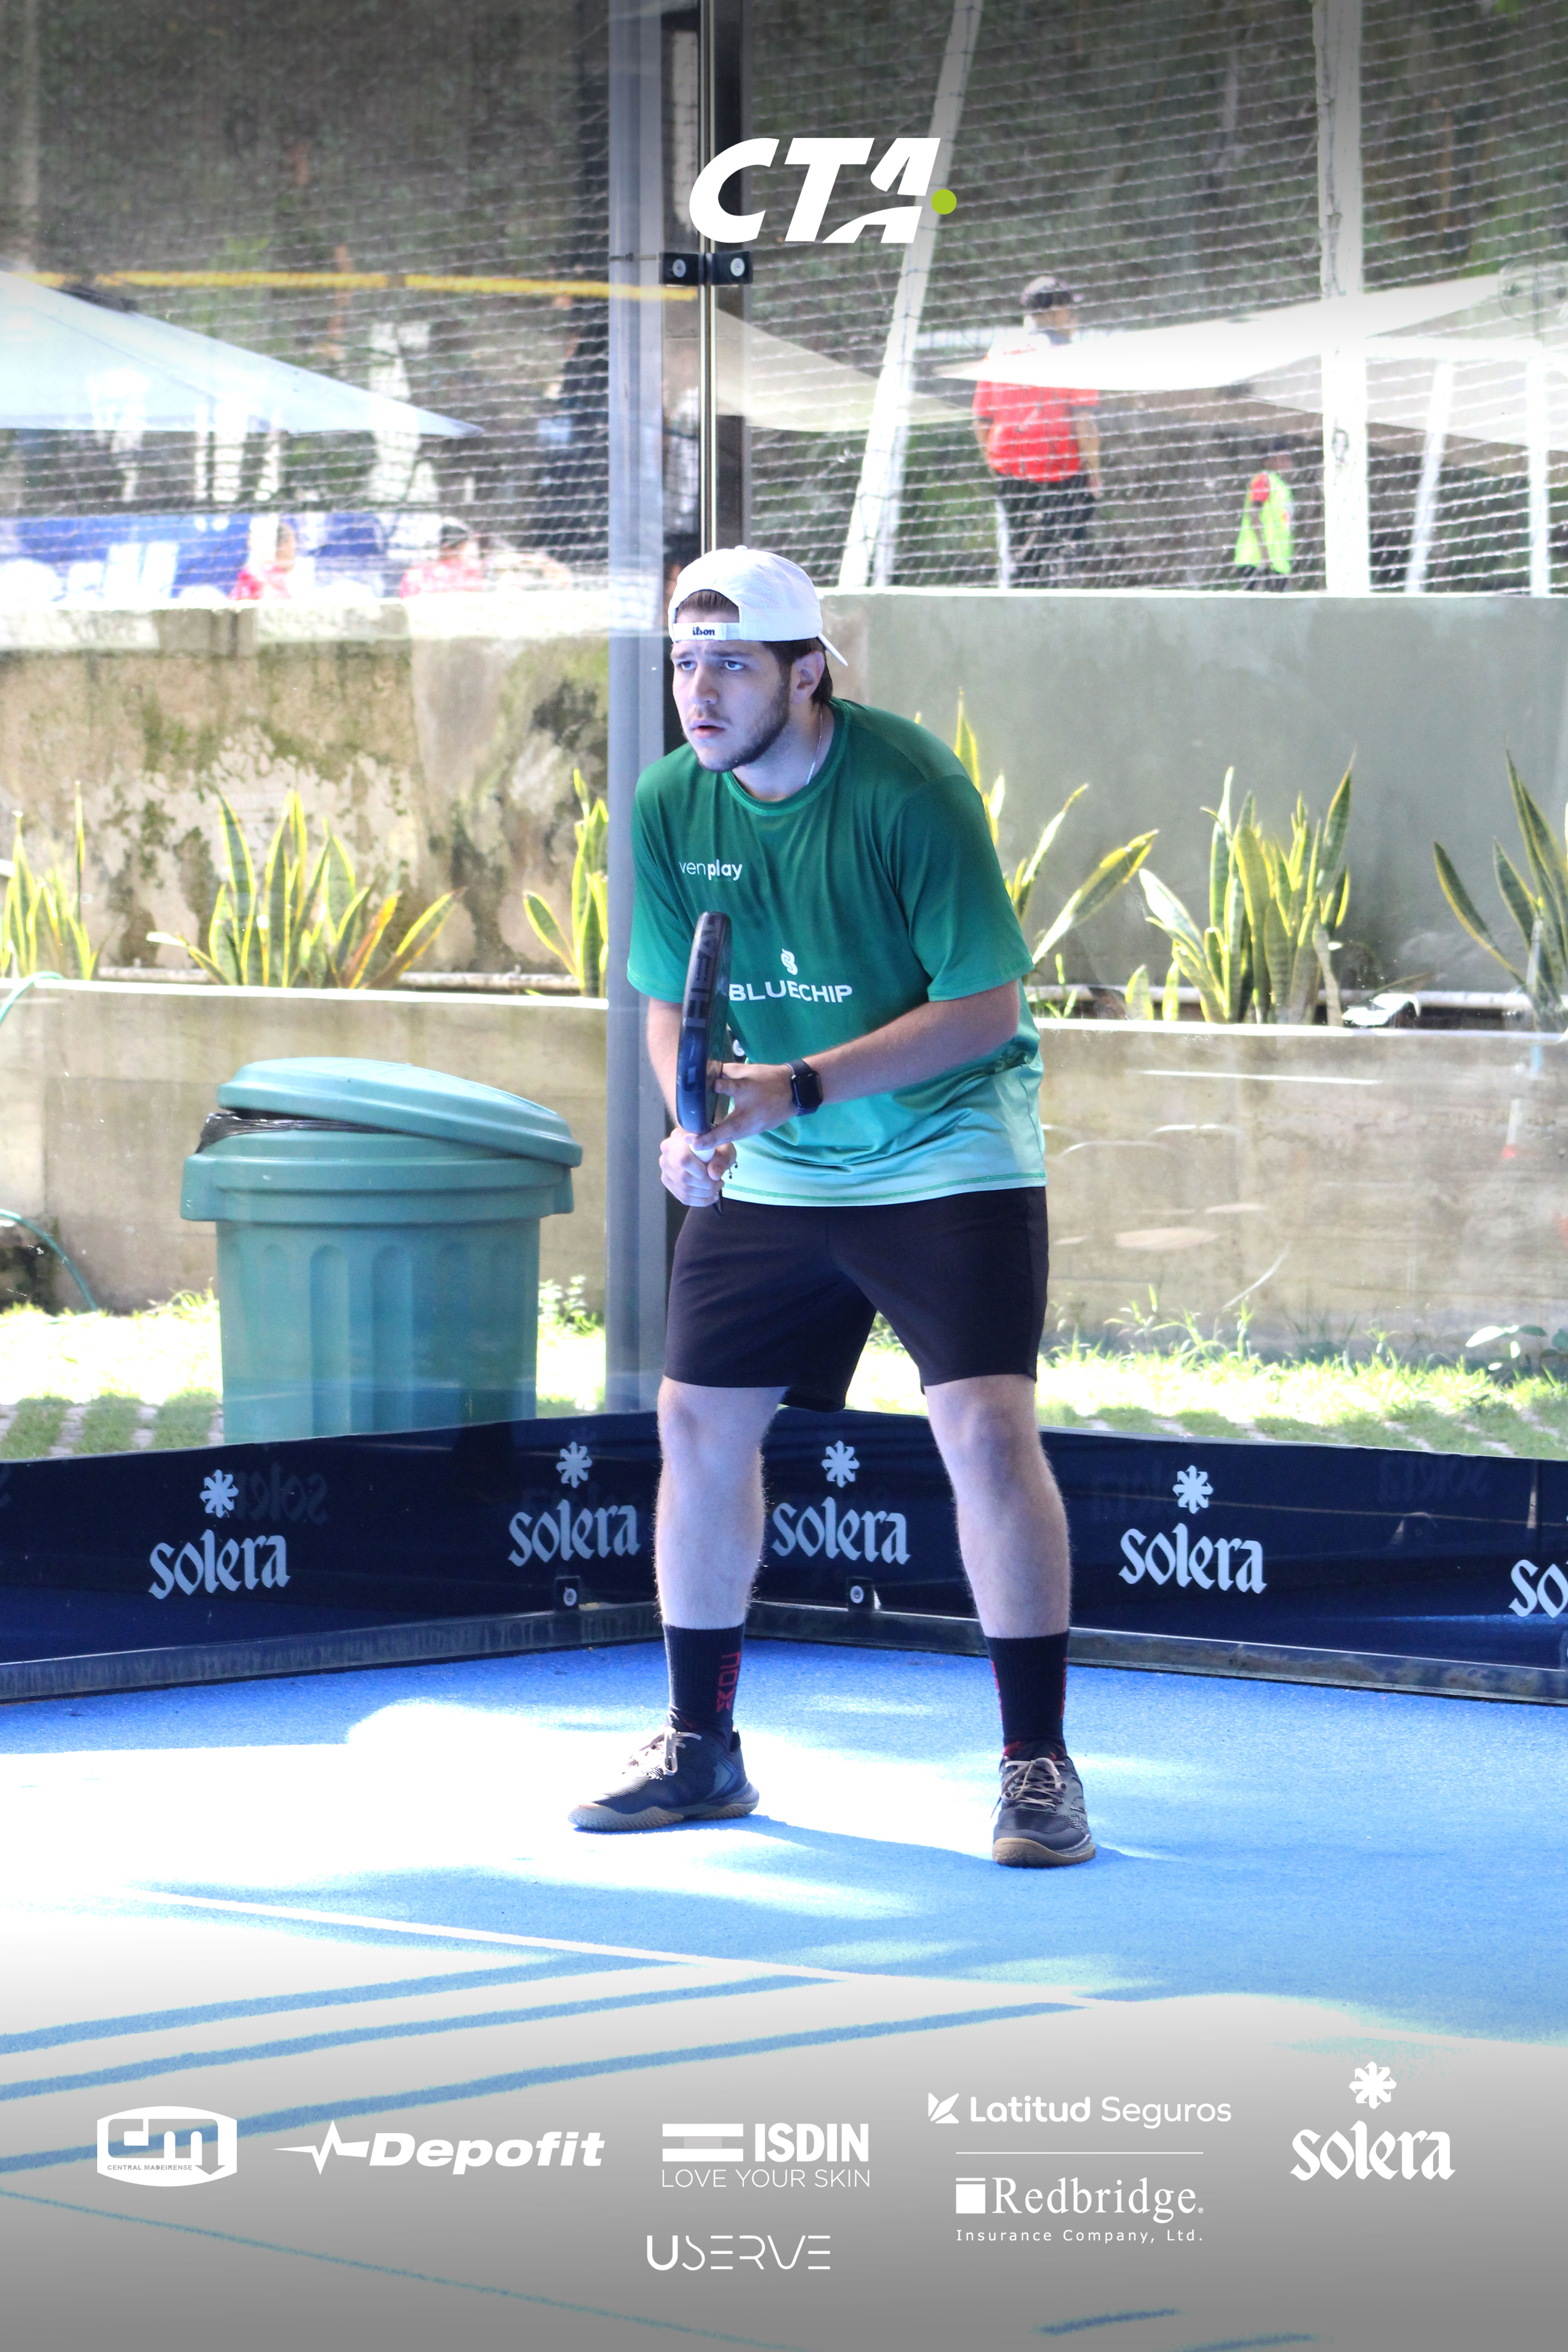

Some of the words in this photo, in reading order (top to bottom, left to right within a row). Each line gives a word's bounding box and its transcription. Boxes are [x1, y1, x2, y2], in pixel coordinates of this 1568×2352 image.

[679, 859, 742, 880] venplay
[729, 980, 852, 1003] BLUECHIP
[508, 1499, 641, 1566] solera
[772, 1496, 910, 1564] solera
[1118, 1523, 1267, 1594] solera
[149, 1529, 290, 1599] solera
[1508, 1559, 1568, 1618] so
